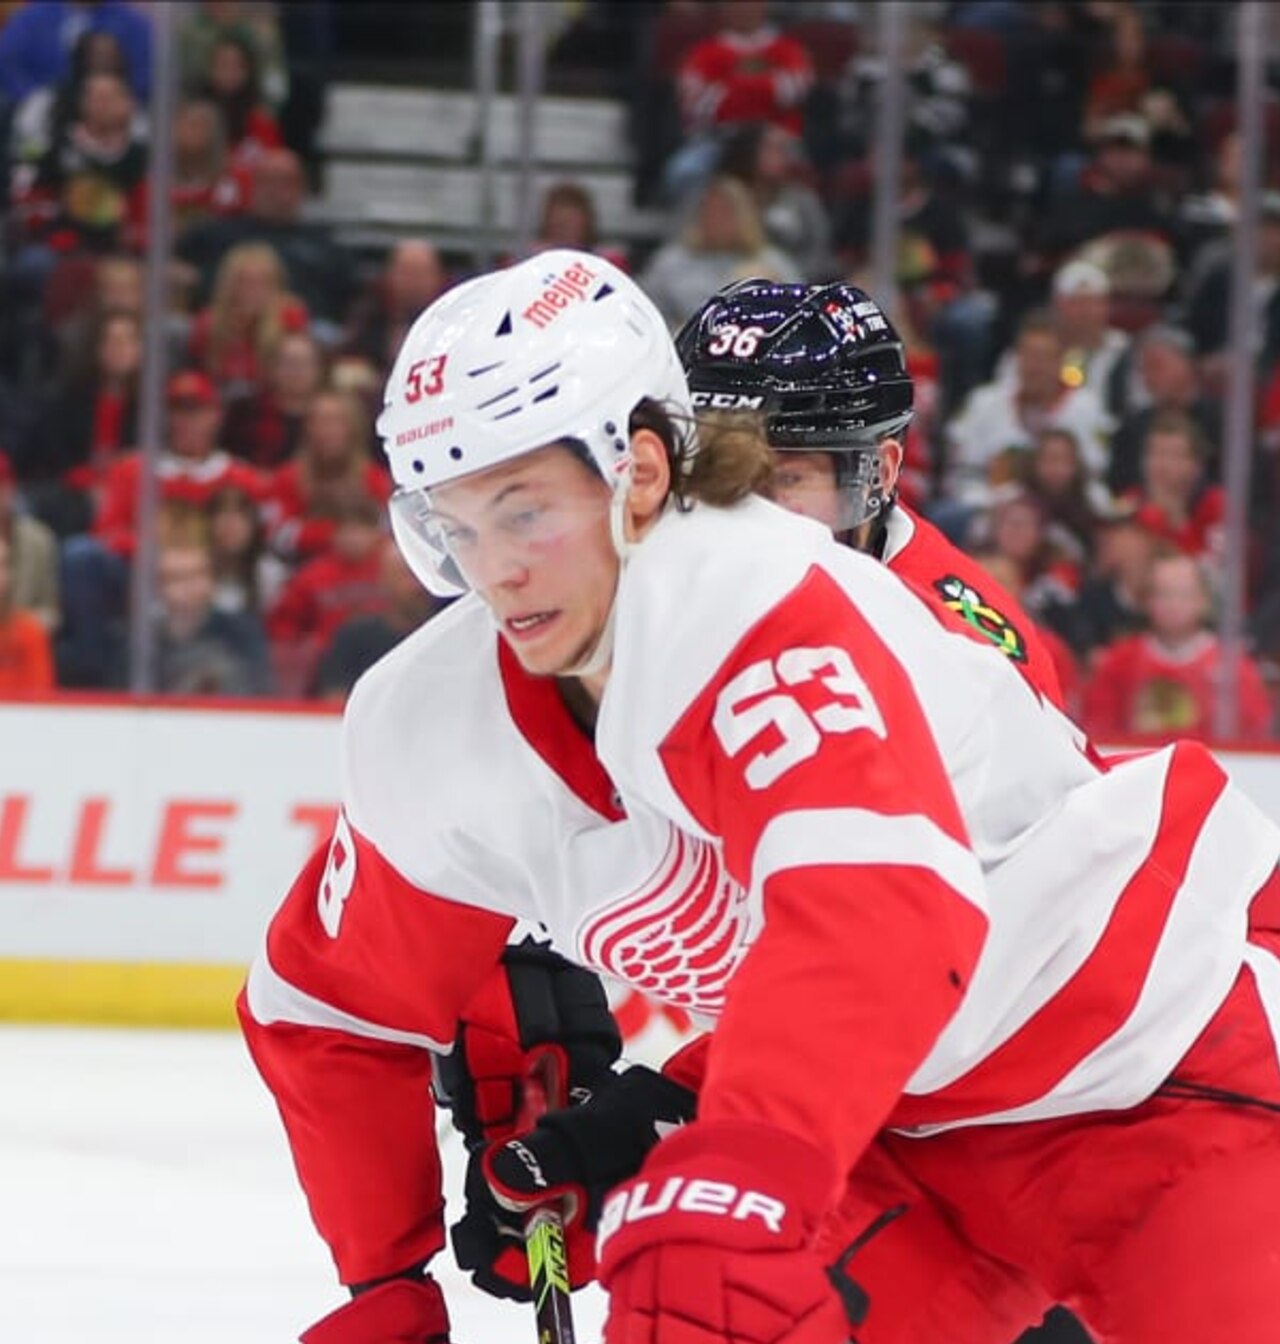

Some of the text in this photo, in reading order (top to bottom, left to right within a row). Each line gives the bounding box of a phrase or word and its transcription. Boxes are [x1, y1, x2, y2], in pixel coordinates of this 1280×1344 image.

[522, 261, 597, 329] meijer
[708, 324, 764, 357] 36
[405, 354, 448, 404] 53
[712, 645, 888, 791] 53
